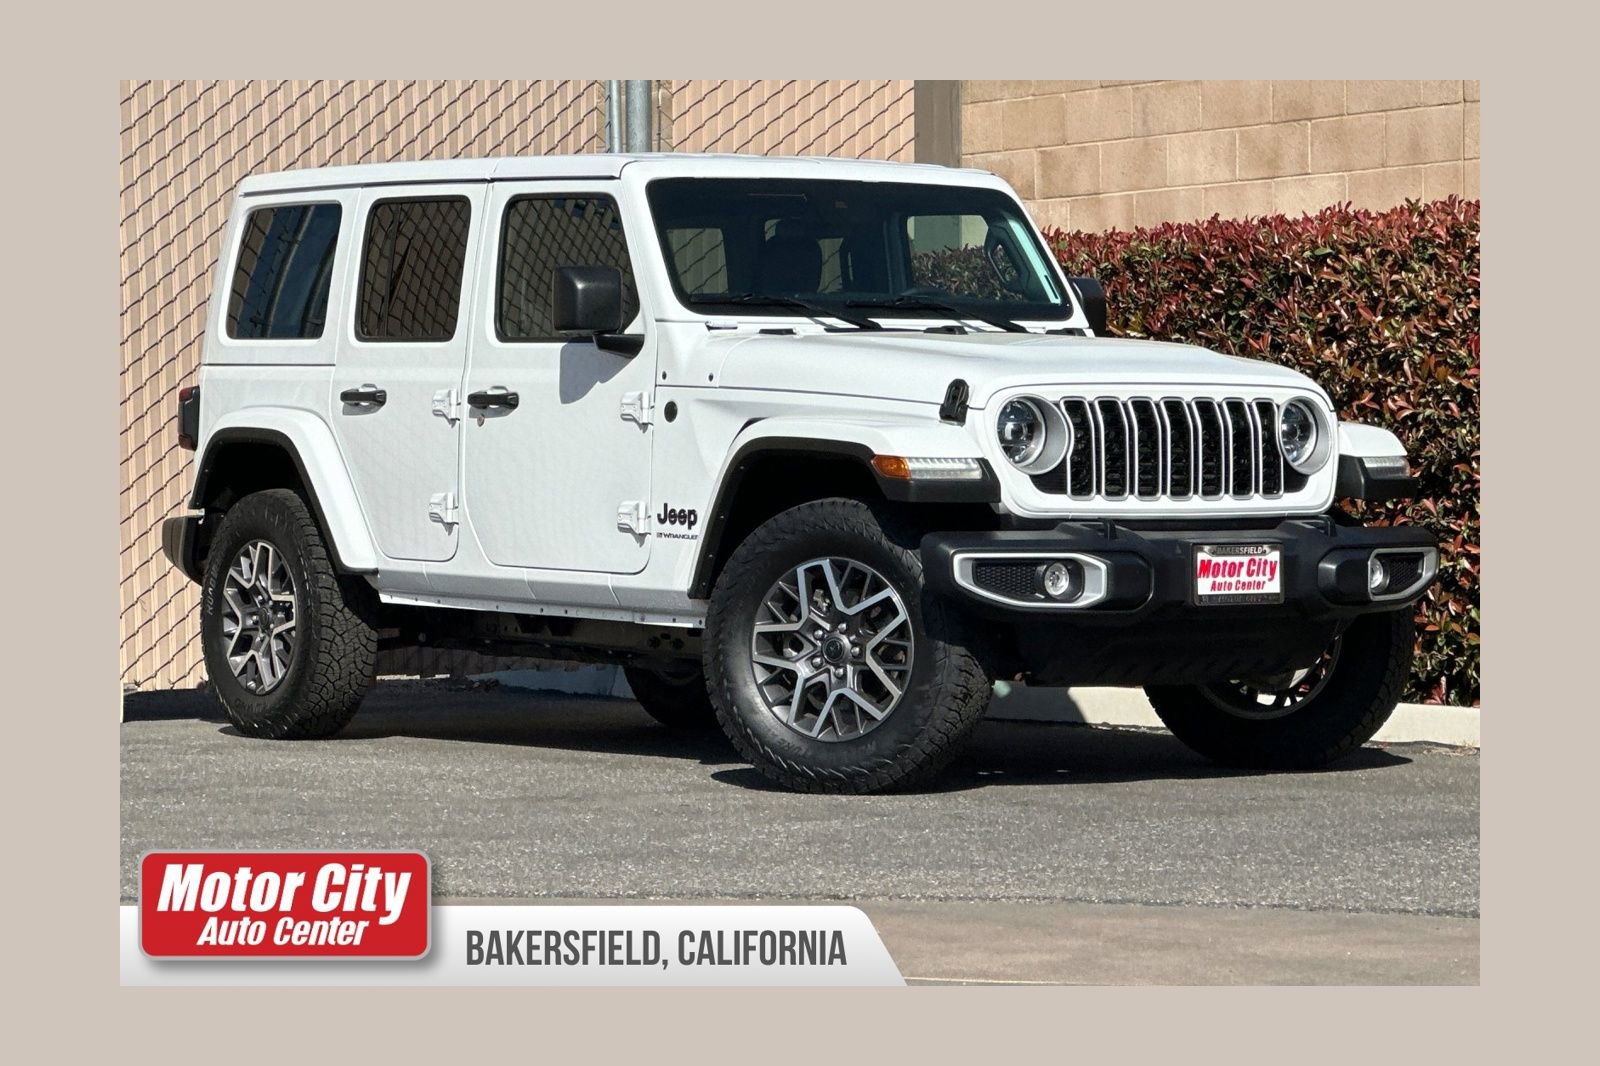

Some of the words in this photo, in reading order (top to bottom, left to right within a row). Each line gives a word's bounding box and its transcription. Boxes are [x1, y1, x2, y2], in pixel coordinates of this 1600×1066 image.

[657, 502, 698, 530] Jeep
[1217, 546, 1263, 554] BAKERSFIELD
[1197, 559, 1245, 579] Motor
[1246, 557, 1278, 582] City
[1210, 580, 1233, 592] Auto
[1234, 579, 1267, 591] Center
